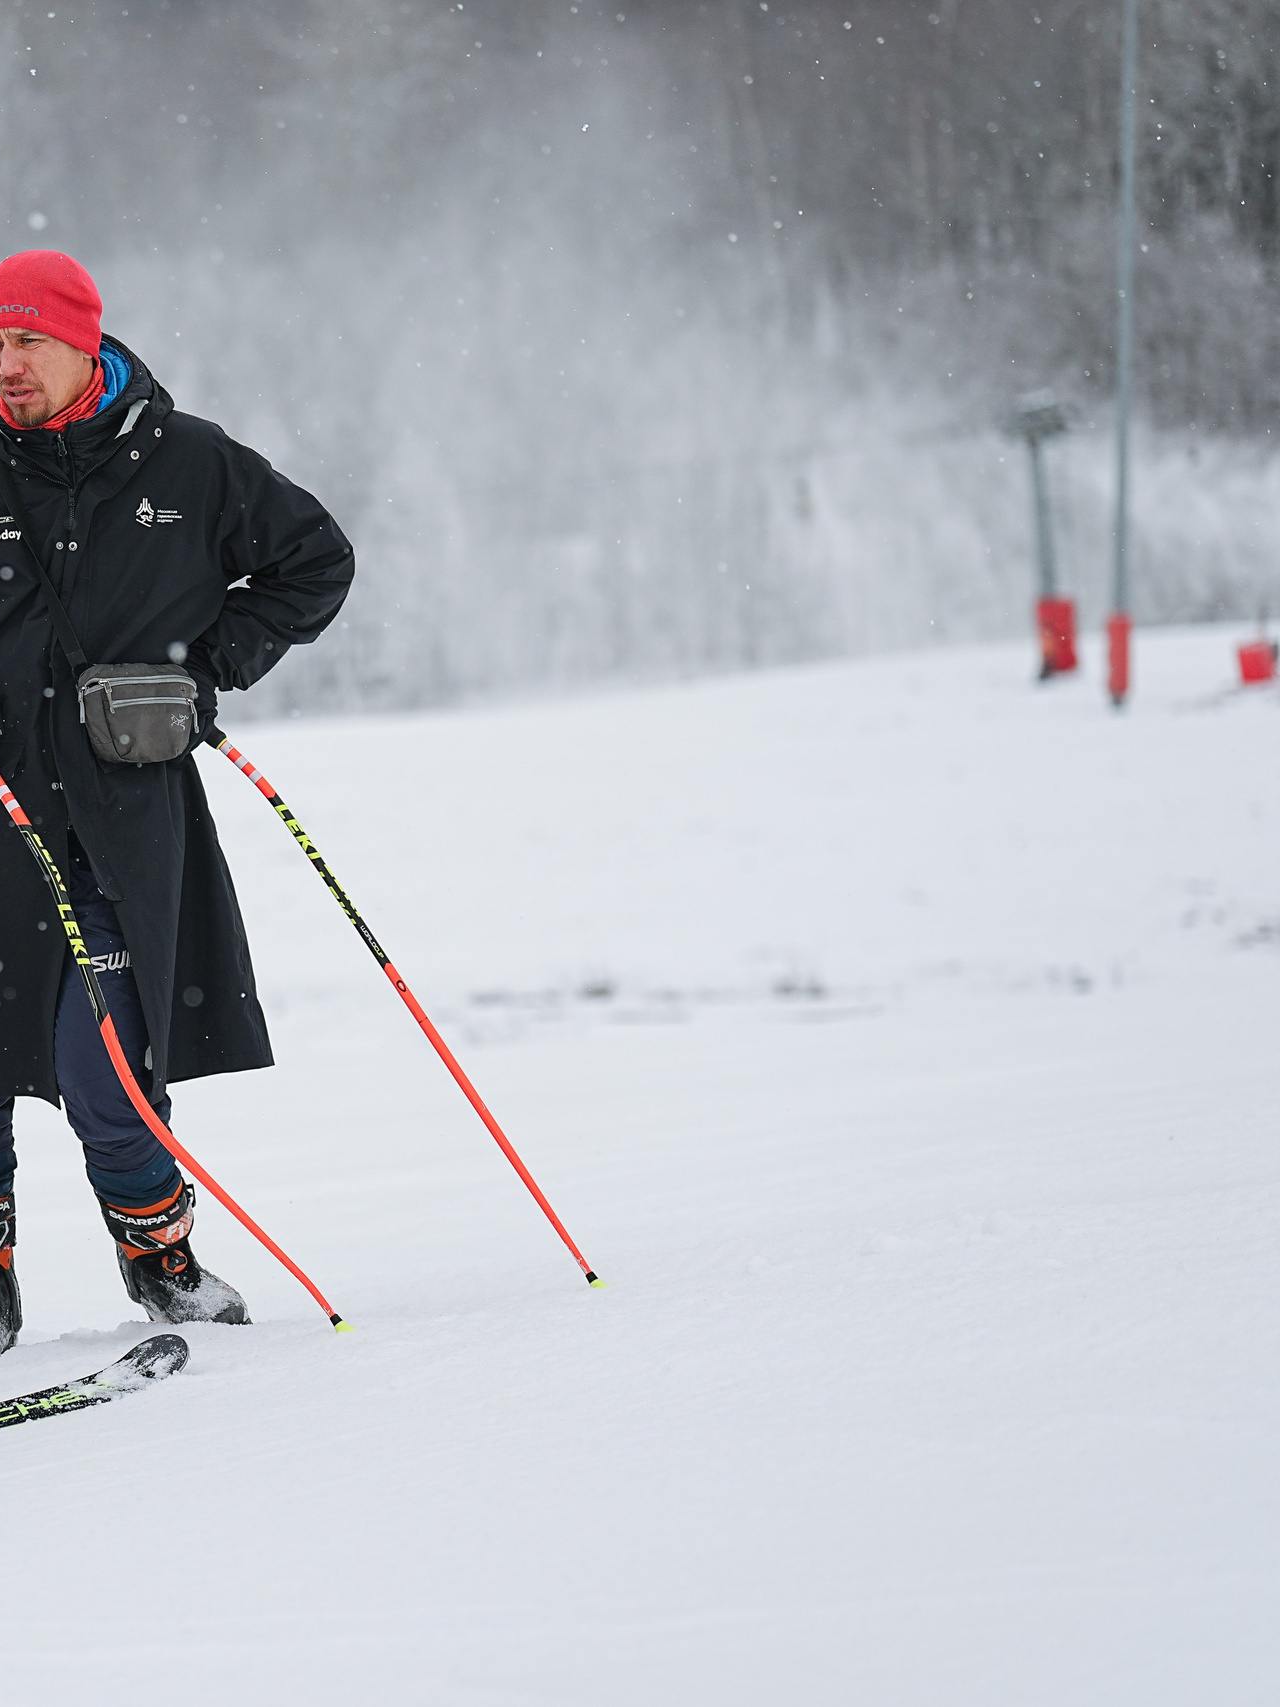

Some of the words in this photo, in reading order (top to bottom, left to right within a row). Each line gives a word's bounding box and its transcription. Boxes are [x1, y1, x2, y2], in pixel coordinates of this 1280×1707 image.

[275, 804, 322, 860] LEKI
[57, 904, 91, 965] LEKI
[90, 950, 131, 973] SWI
[108, 1210, 169, 1226] SCARPA
[166, 1221, 185, 1239] F1
